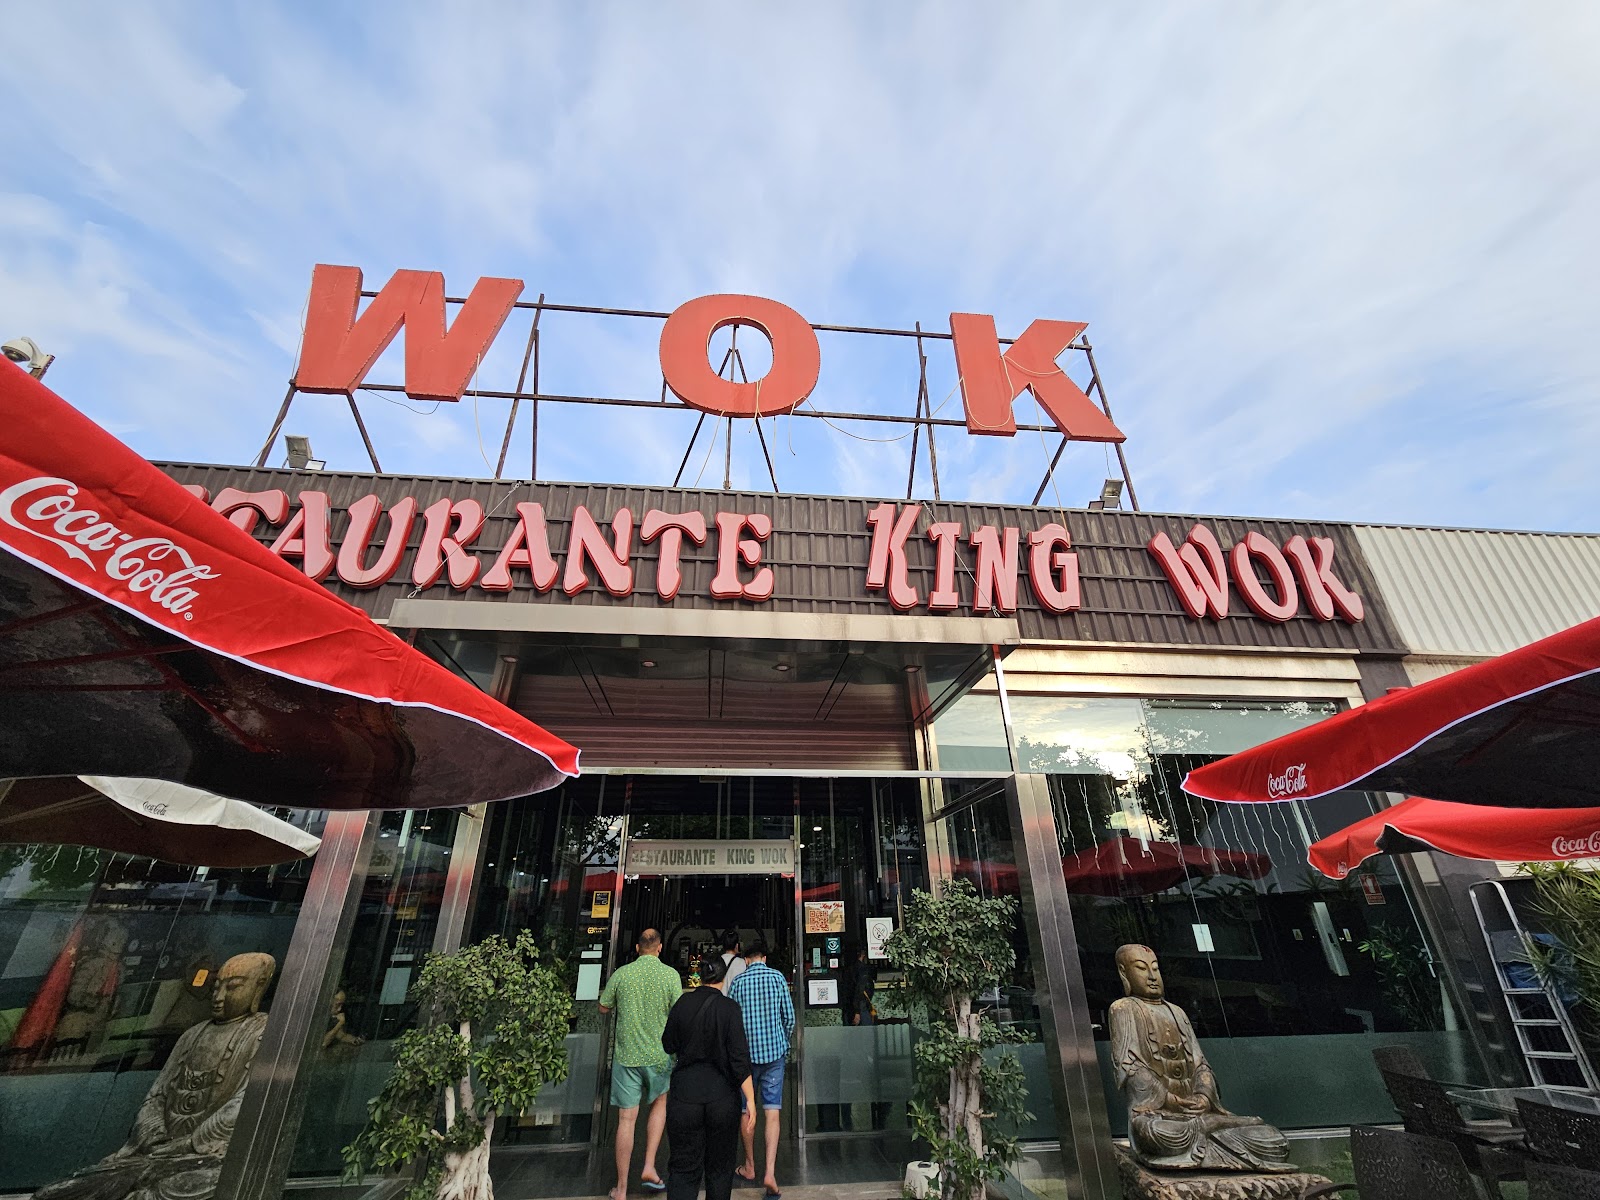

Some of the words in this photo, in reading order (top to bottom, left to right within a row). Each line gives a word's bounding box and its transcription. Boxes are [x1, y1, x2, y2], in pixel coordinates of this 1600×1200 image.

[295, 263, 1126, 442] WOK
[184, 484, 775, 600] TAURANTE
[865, 502, 1081, 615] KING
[1147, 523, 1364, 624] WOK
[726, 849, 755, 865] KING
[761, 848, 787, 864] WOK
